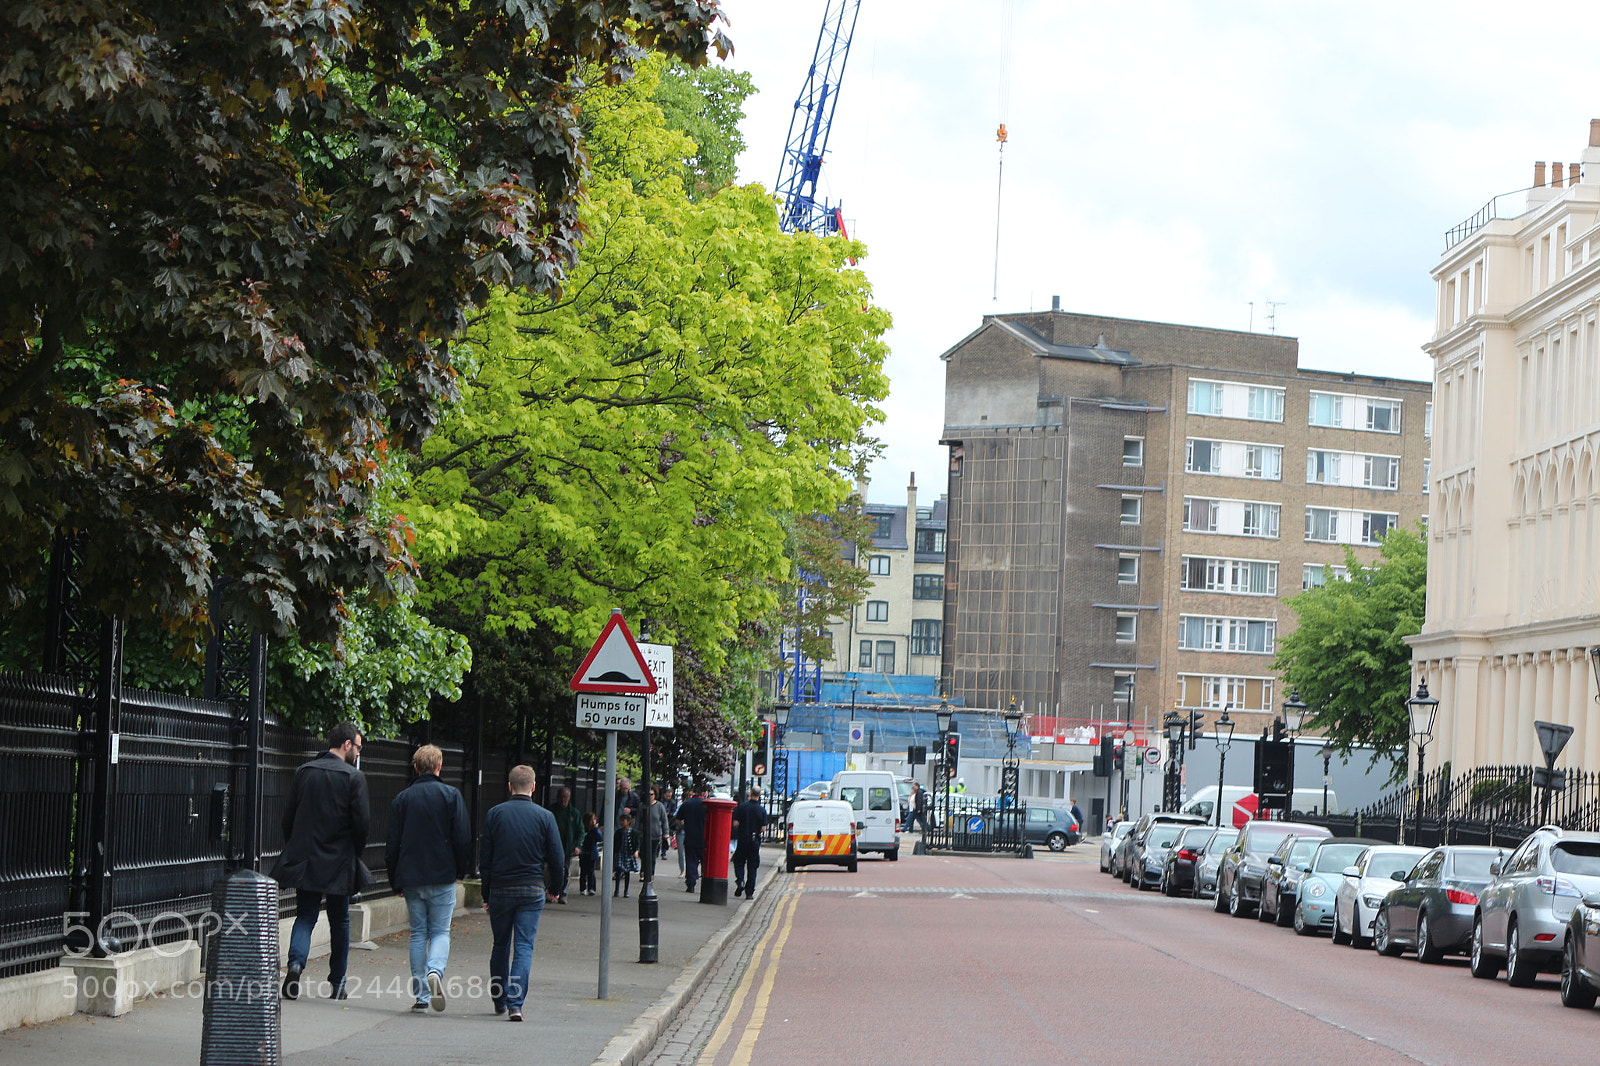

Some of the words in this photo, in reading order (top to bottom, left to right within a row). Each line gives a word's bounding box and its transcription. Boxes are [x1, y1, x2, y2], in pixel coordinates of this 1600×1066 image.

[580, 697, 620, 712] Humps
[624, 701, 641, 712] for
[584, 712, 600, 723] 50
[604, 715, 636, 726] yards
